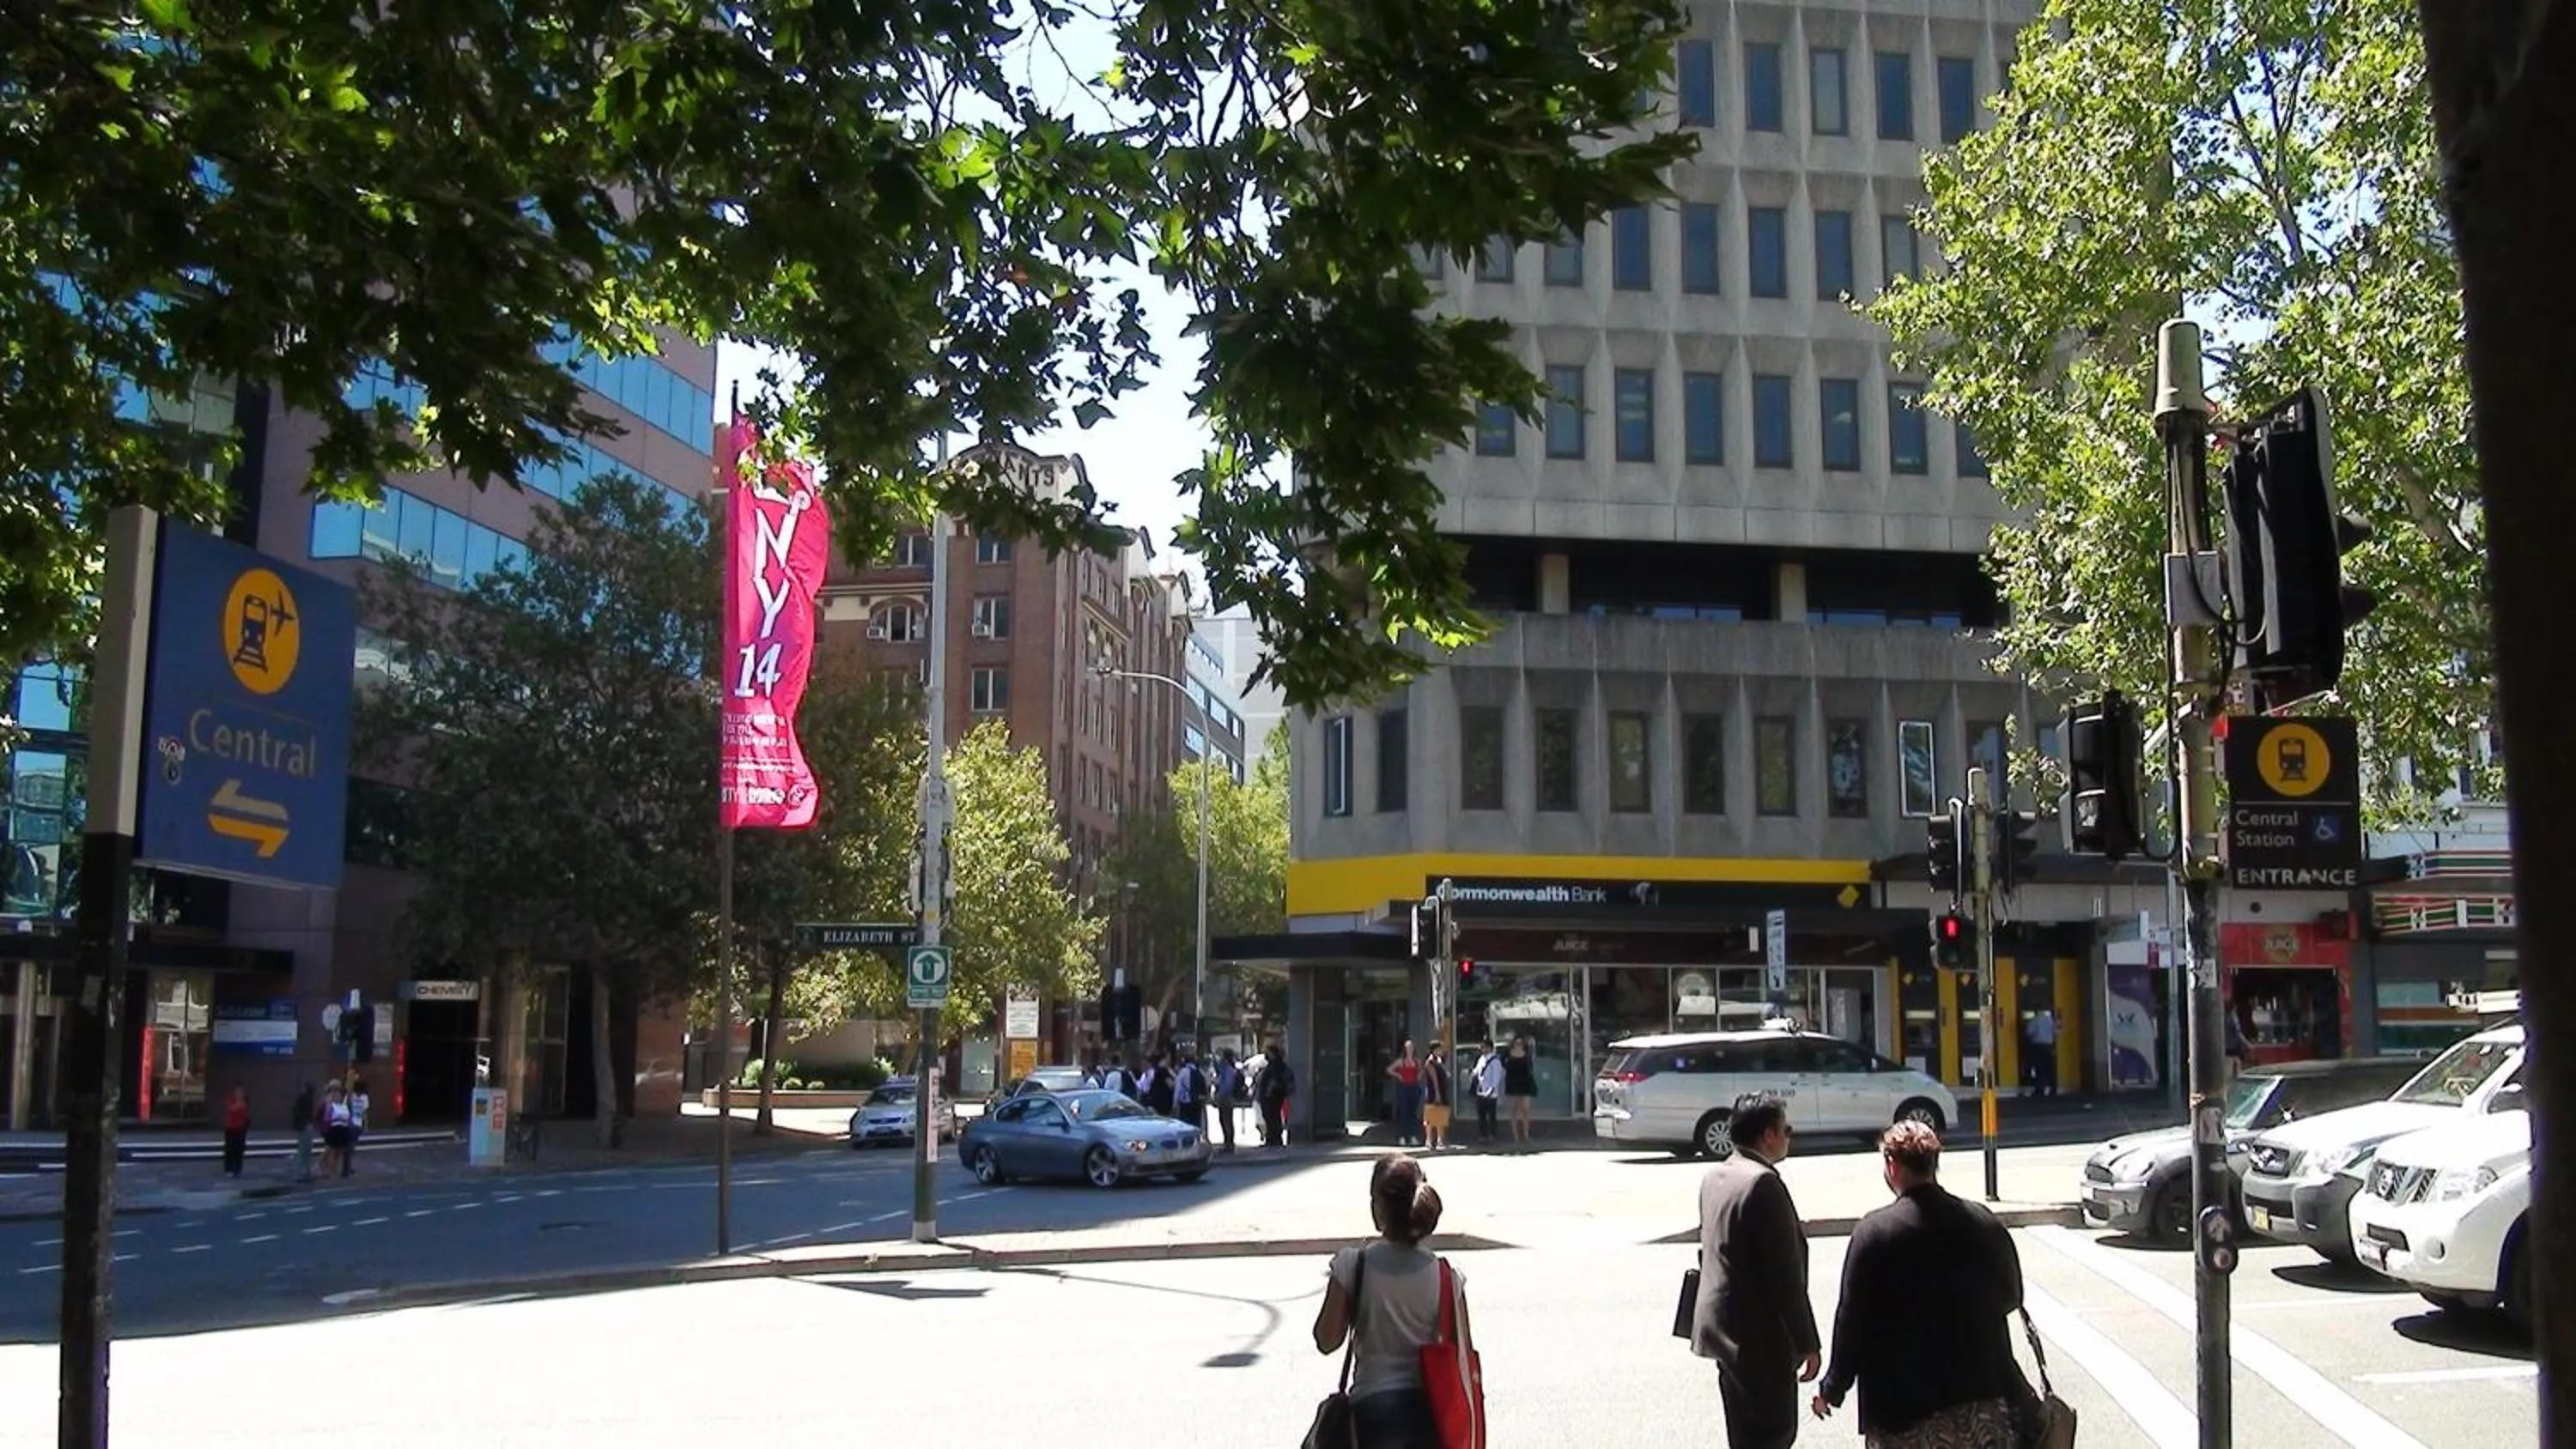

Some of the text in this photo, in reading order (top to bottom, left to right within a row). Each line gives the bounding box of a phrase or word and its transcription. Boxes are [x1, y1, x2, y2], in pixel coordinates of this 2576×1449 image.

[734, 643, 782, 698] 14
[190, 708, 316, 778] Central
[2236, 809, 2299, 826] Central
[2236, 830, 2295, 846] Station
[2238, 869, 2357, 885] ENTRANCE
[1572, 886, 1607, 902] Bank
[823, 930, 916, 943] ELIZABETH ST
